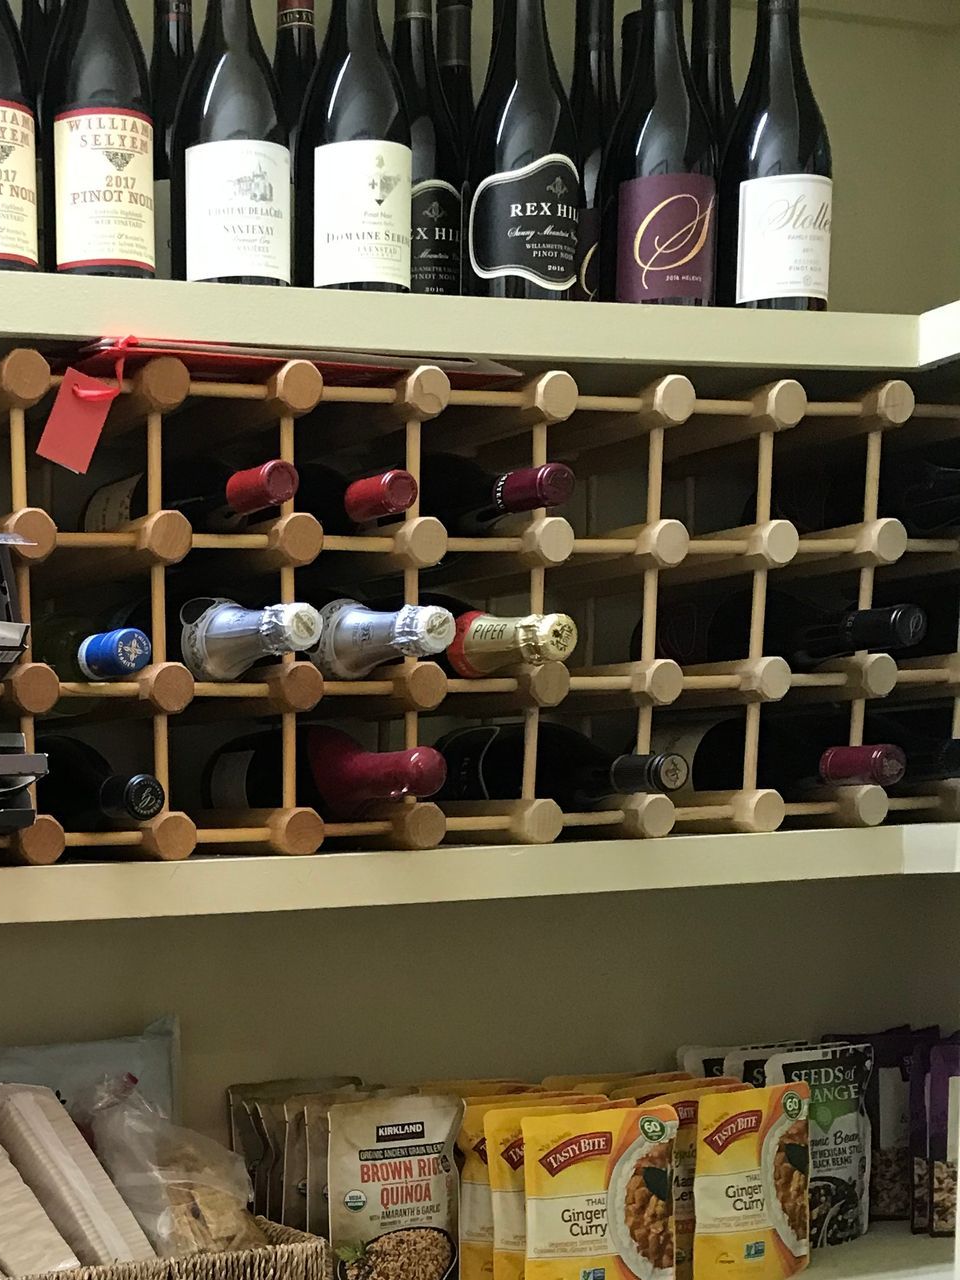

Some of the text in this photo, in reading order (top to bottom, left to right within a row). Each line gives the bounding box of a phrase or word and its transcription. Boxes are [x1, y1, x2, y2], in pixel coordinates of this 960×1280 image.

[67, 117, 153, 141] WILLIAM
[80, 134, 148, 154] SELYEM
[105, 175, 136, 189] 2017
[70, 189, 123, 205] PINOT
[510, 202, 551, 218] REX
[326, 231, 381, 245] DOMAINE
[532, 250, 558, 259] PINOT
[472, 623, 506, 641] PIPER
[791, 1066, 844, 1087] SEEDS
[810, 1084, 860, 1103] ANGE
[678, 1106, 695, 1120] BITE
[786, 1099, 800, 1112] 60
[378, 1124, 423, 1136] KIRKLAND
[643, 1121, 660, 1134] 60
[712, 1115, 758, 1148] TASTY BITE
[833, 1130, 860, 1146] Bean
[547, 1143, 581, 1169] TASTY
[580, 1136, 607, 1152] BITE
[360, 1160, 413, 1184] BROWN
[380, 1182, 432, 1210] QUINOA
[725, 1185, 763, 1204] Ginger
[381, 1206, 416, 1221] AMARANTH
[732, 1199, 764, 1213] Curry
[561, 1207, 607, 1225] Ginger
[569, 1222, 608, 1239] Curry
